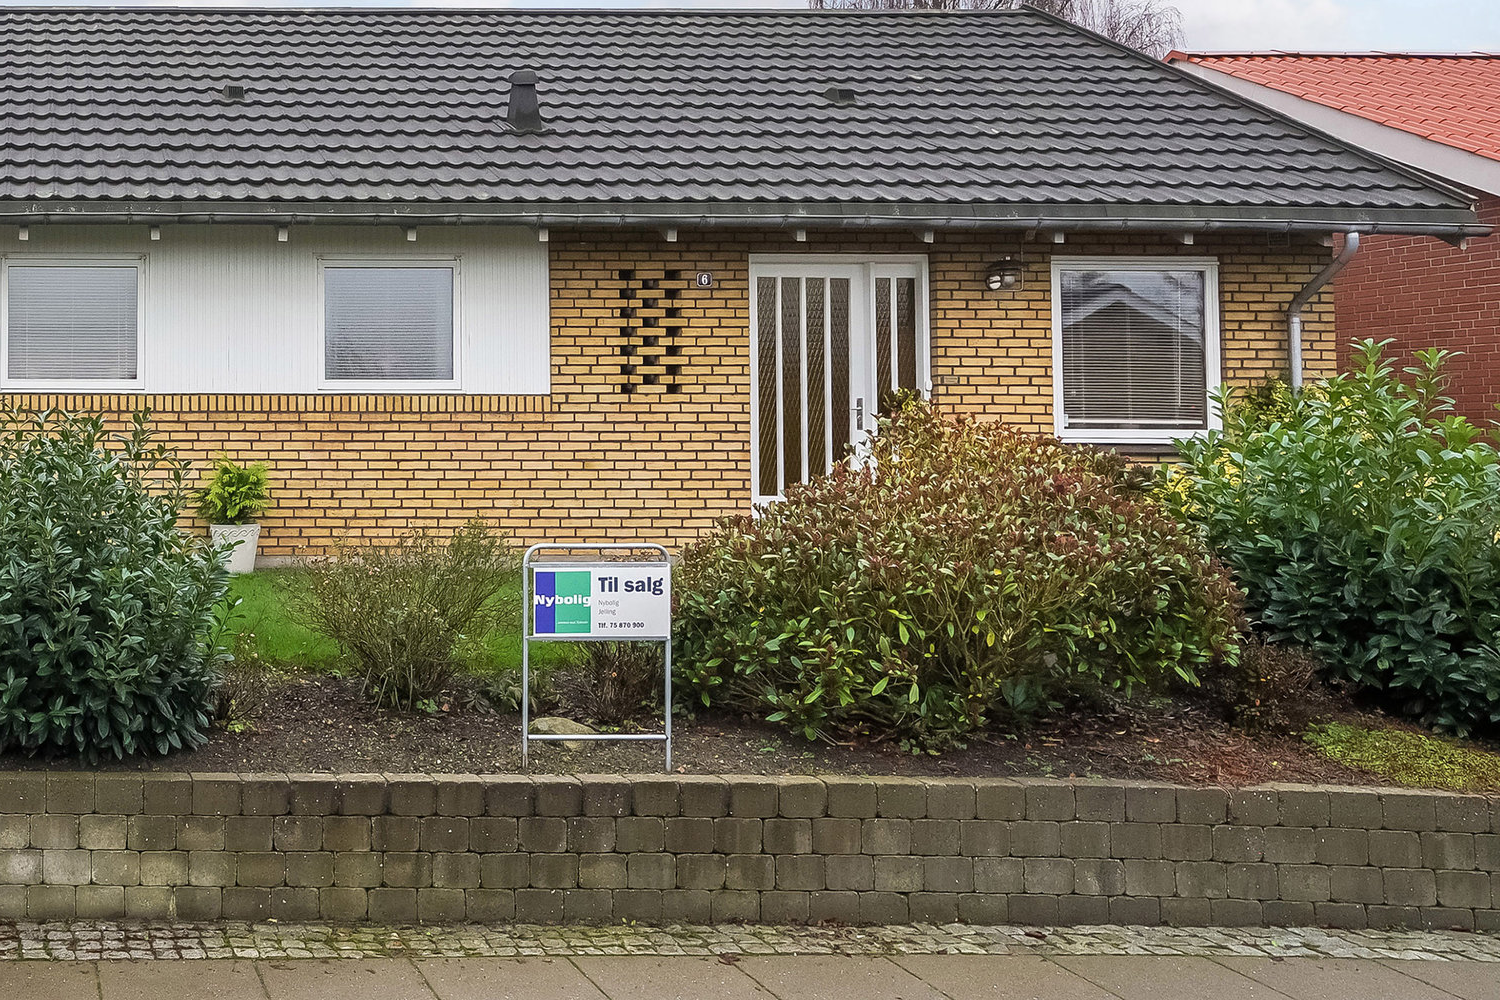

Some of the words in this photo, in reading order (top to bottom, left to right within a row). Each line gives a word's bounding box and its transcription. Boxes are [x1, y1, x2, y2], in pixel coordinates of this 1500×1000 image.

[598, 577, 618, 592] Til
[624, 577, 664, 596] salg
[534, 595, 591, 607] Nybolig
